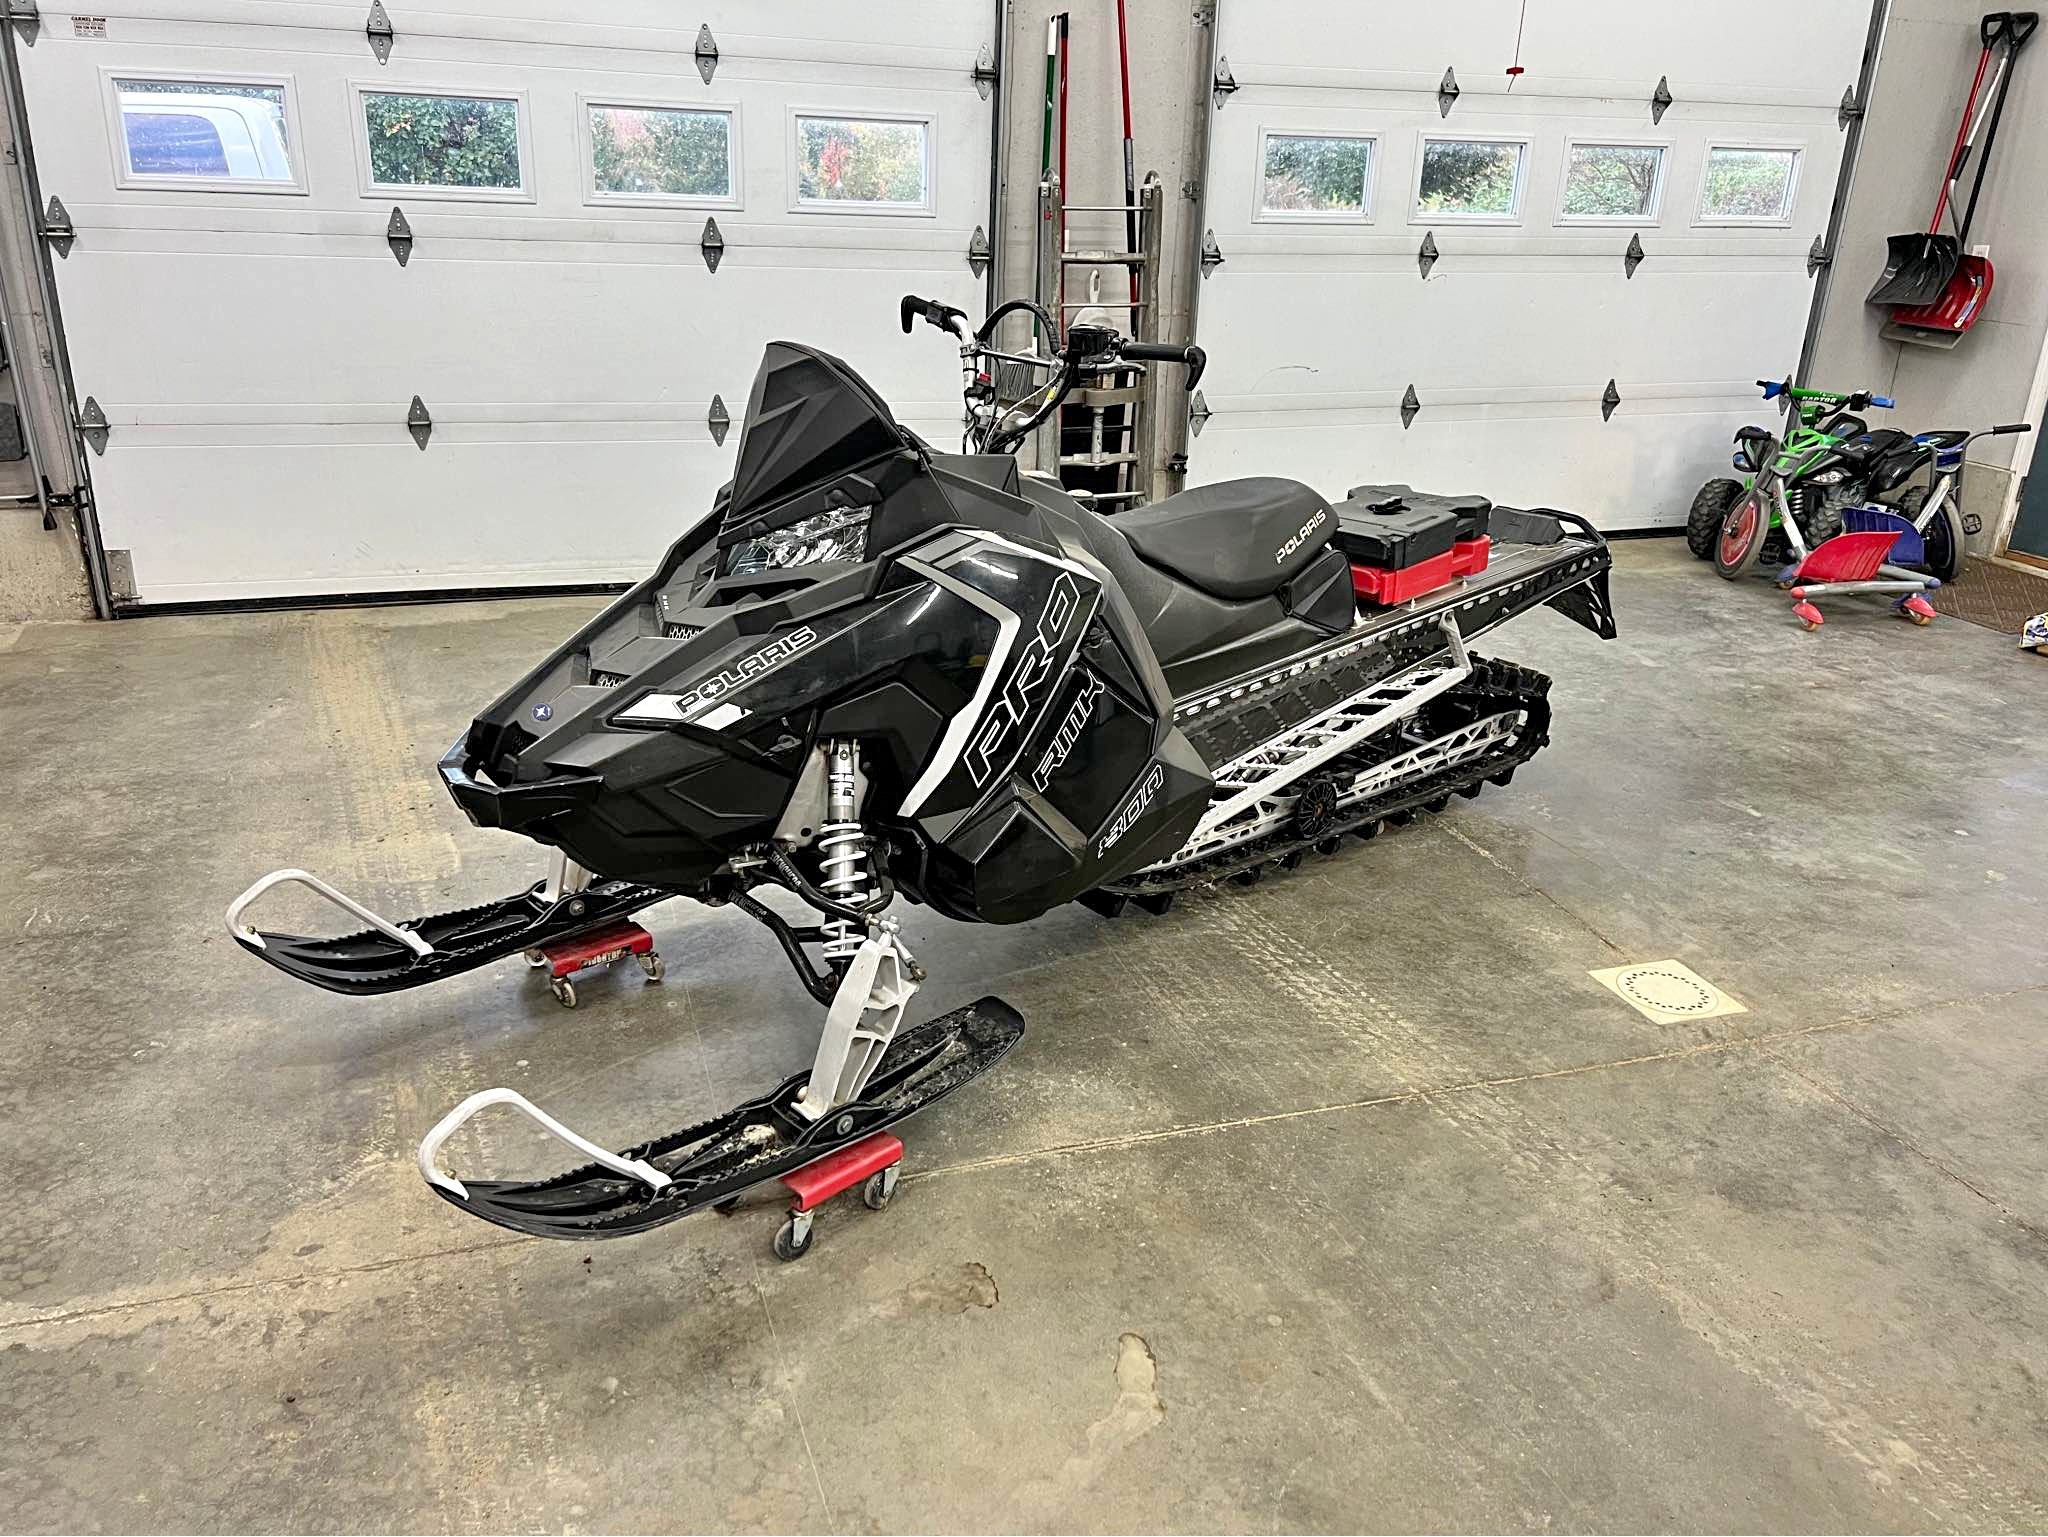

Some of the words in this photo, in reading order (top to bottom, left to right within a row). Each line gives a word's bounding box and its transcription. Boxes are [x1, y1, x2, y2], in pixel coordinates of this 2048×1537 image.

[1275, 508, 1327, 565] POLARIS
[673, 625, 818, 718] POLARIS
[963, 571, 1081, 788] PRO
[1032, 668, 1105, 793] RMK
